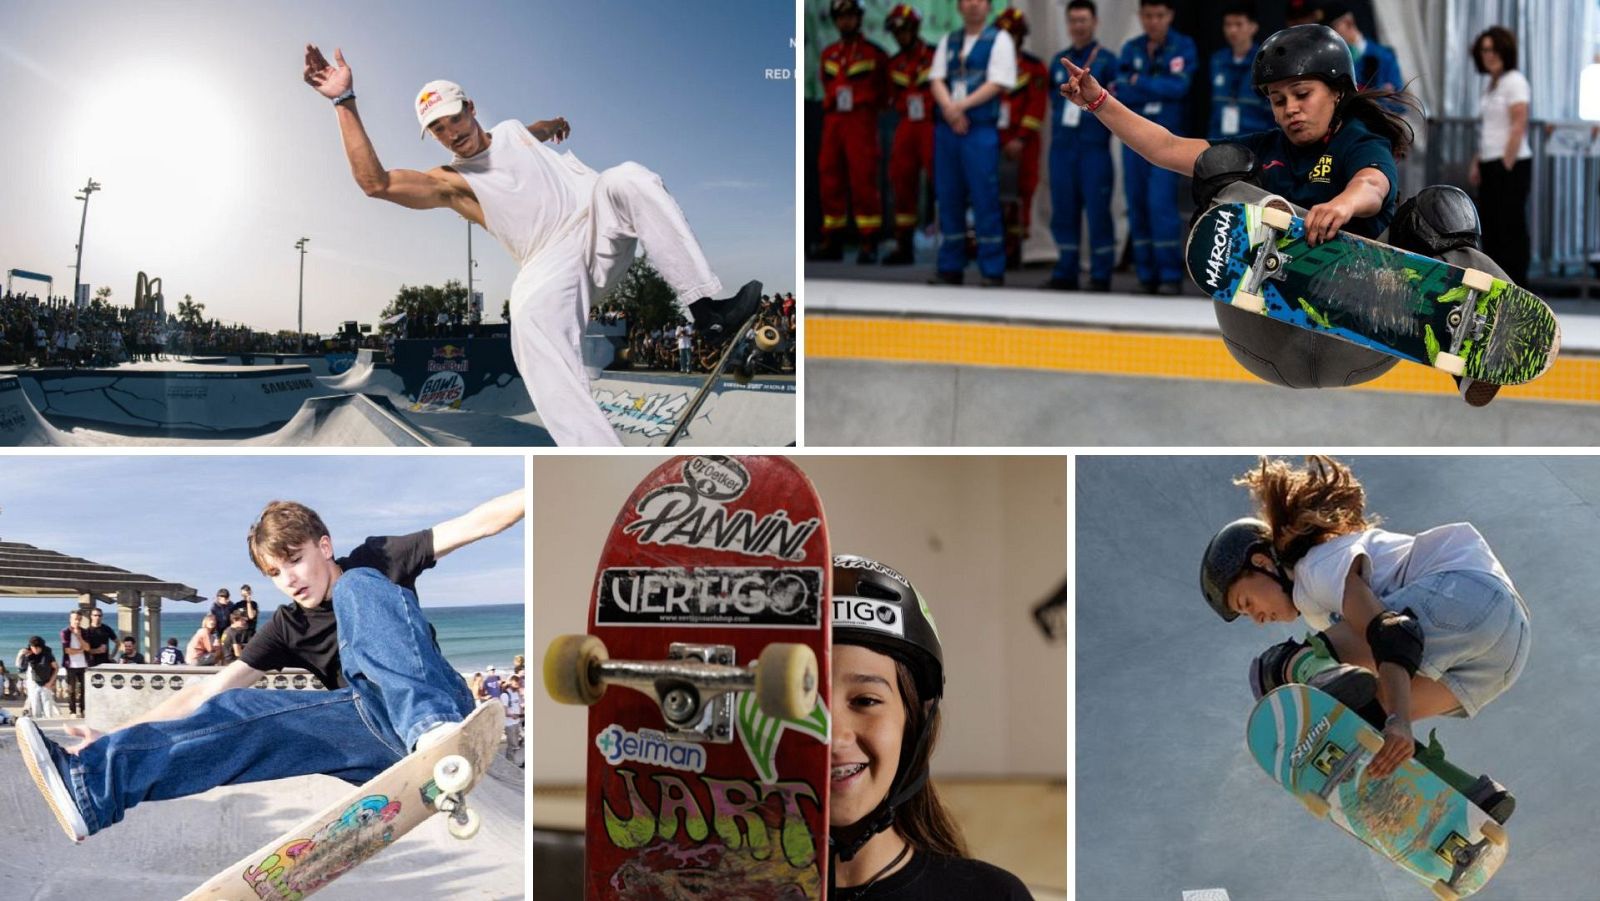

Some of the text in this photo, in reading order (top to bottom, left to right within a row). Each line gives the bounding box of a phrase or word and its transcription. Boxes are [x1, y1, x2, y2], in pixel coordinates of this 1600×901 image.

[261, 378, 314, 395] SAMSUNG
[611, 573, 808, 616] VERTIGO
[602, 768, 822, 868] JART
